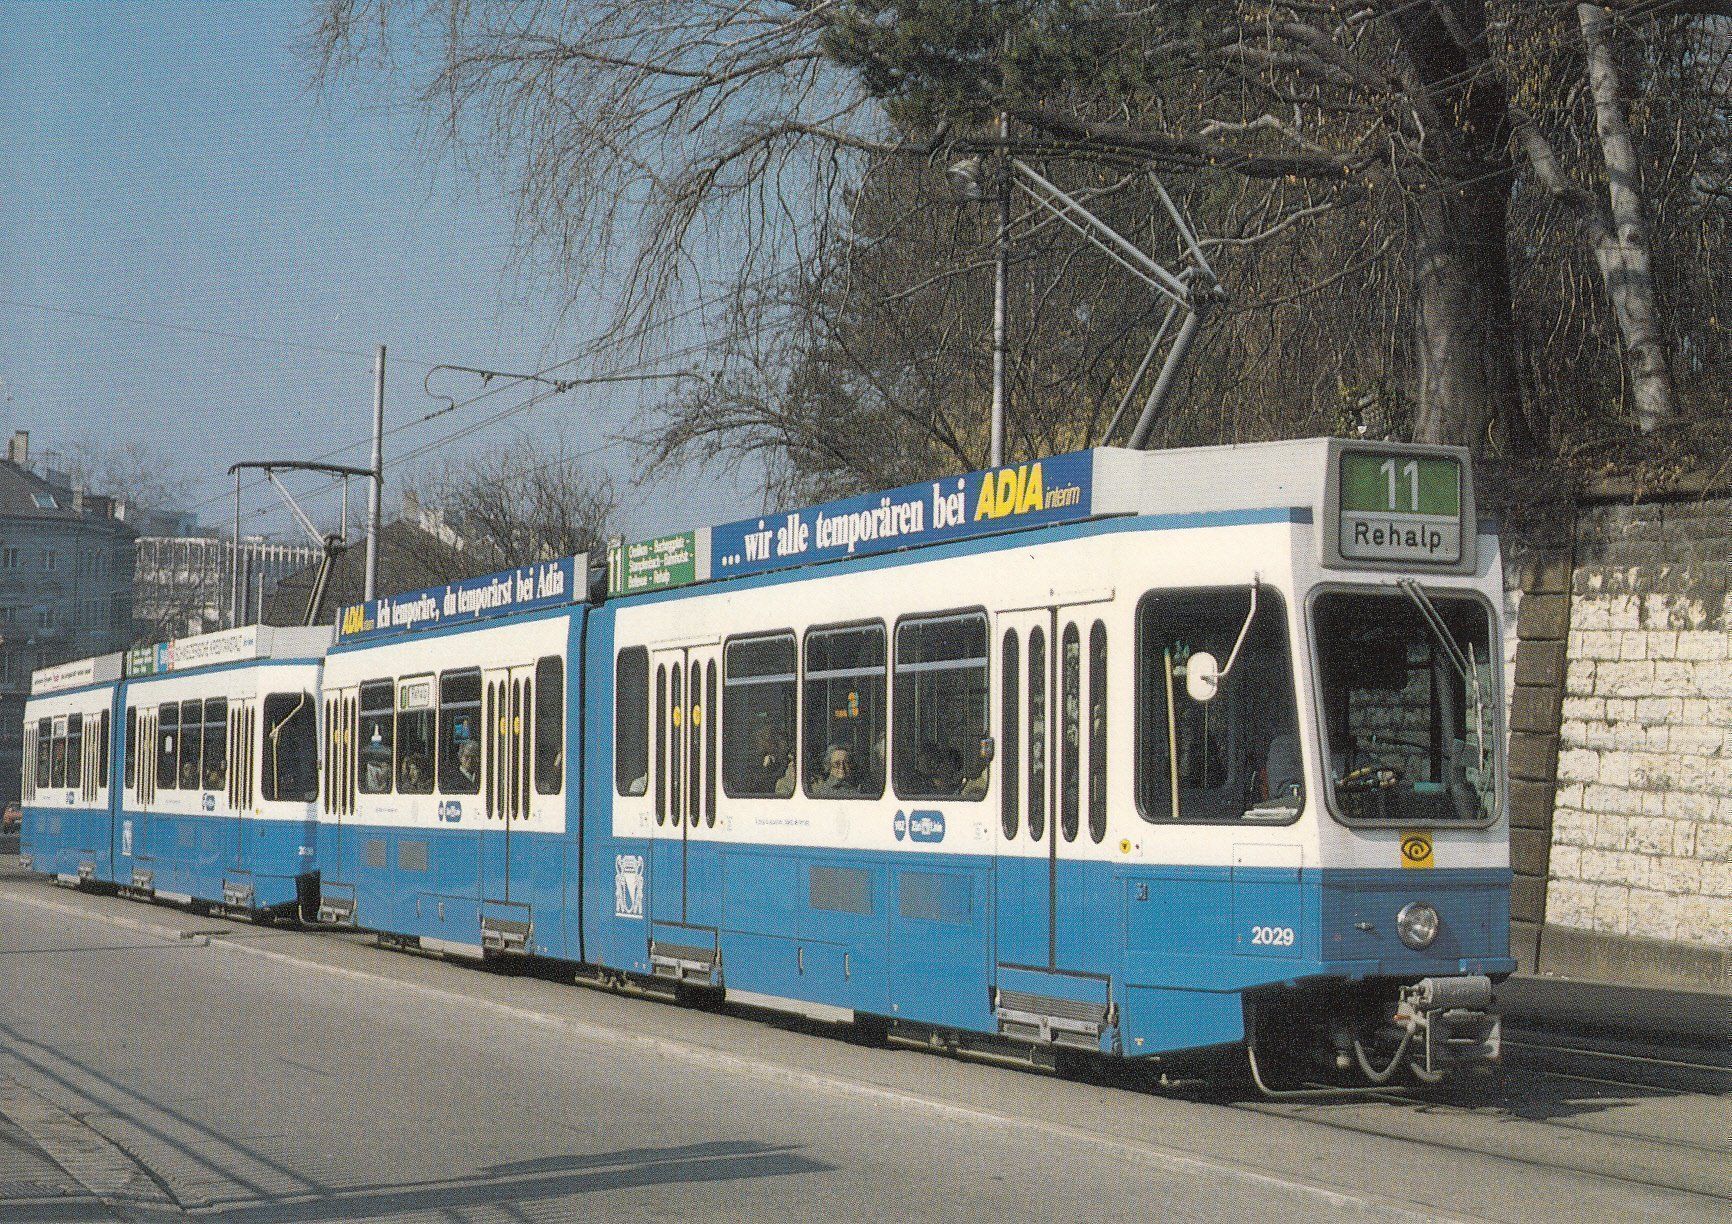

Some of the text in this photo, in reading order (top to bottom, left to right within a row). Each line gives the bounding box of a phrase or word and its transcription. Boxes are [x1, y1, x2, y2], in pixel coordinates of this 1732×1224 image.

[1380, 458, 1420, 511] 11
[744, 519, 773, 562] wir
[777, 513, 809, 557] alle
[815, 496, 924, 553] temporären
[932, 477, 966, 529] bei
[973, 461, 1044, 522] ADIA
[1044, 481, 1081, 509] interim
[1354, 522, 1442, 554] Rehalp
[607, 547, 623, 593] 11
[341, 604, 365, 635] ADIA
[457, 574, 513, 617] temporärst
[516, 567, 534, 603] bei
[536, 561, 564, 599] Adia
[1251, 925, 1295, 946] 2029
